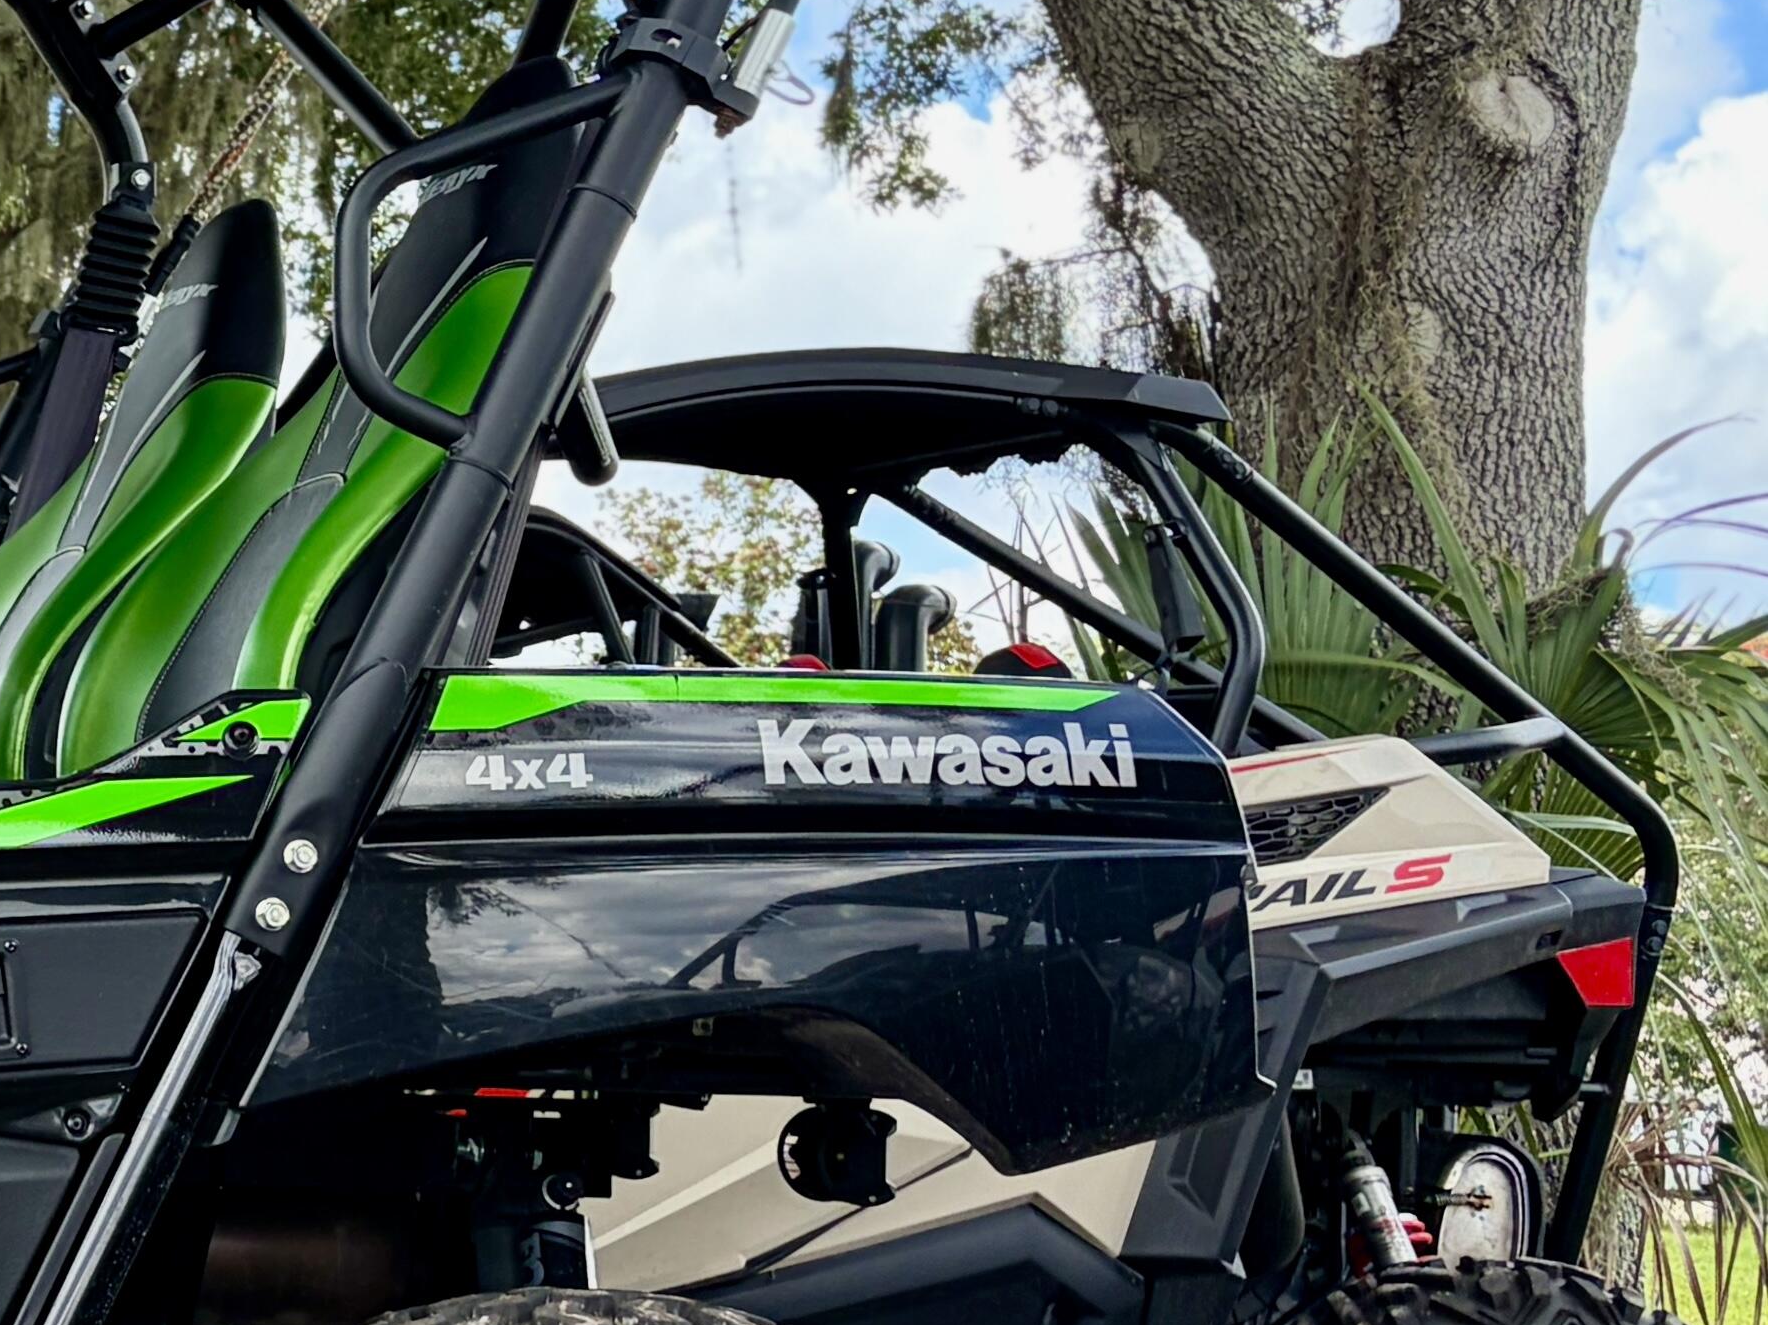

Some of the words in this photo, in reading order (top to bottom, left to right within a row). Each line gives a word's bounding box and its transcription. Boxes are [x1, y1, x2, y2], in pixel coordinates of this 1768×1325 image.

[465, 752, 593, 791] 4x4
[757, 719, 1137, 788] Kawasaki
[1384, 853, 1453, 894] S
